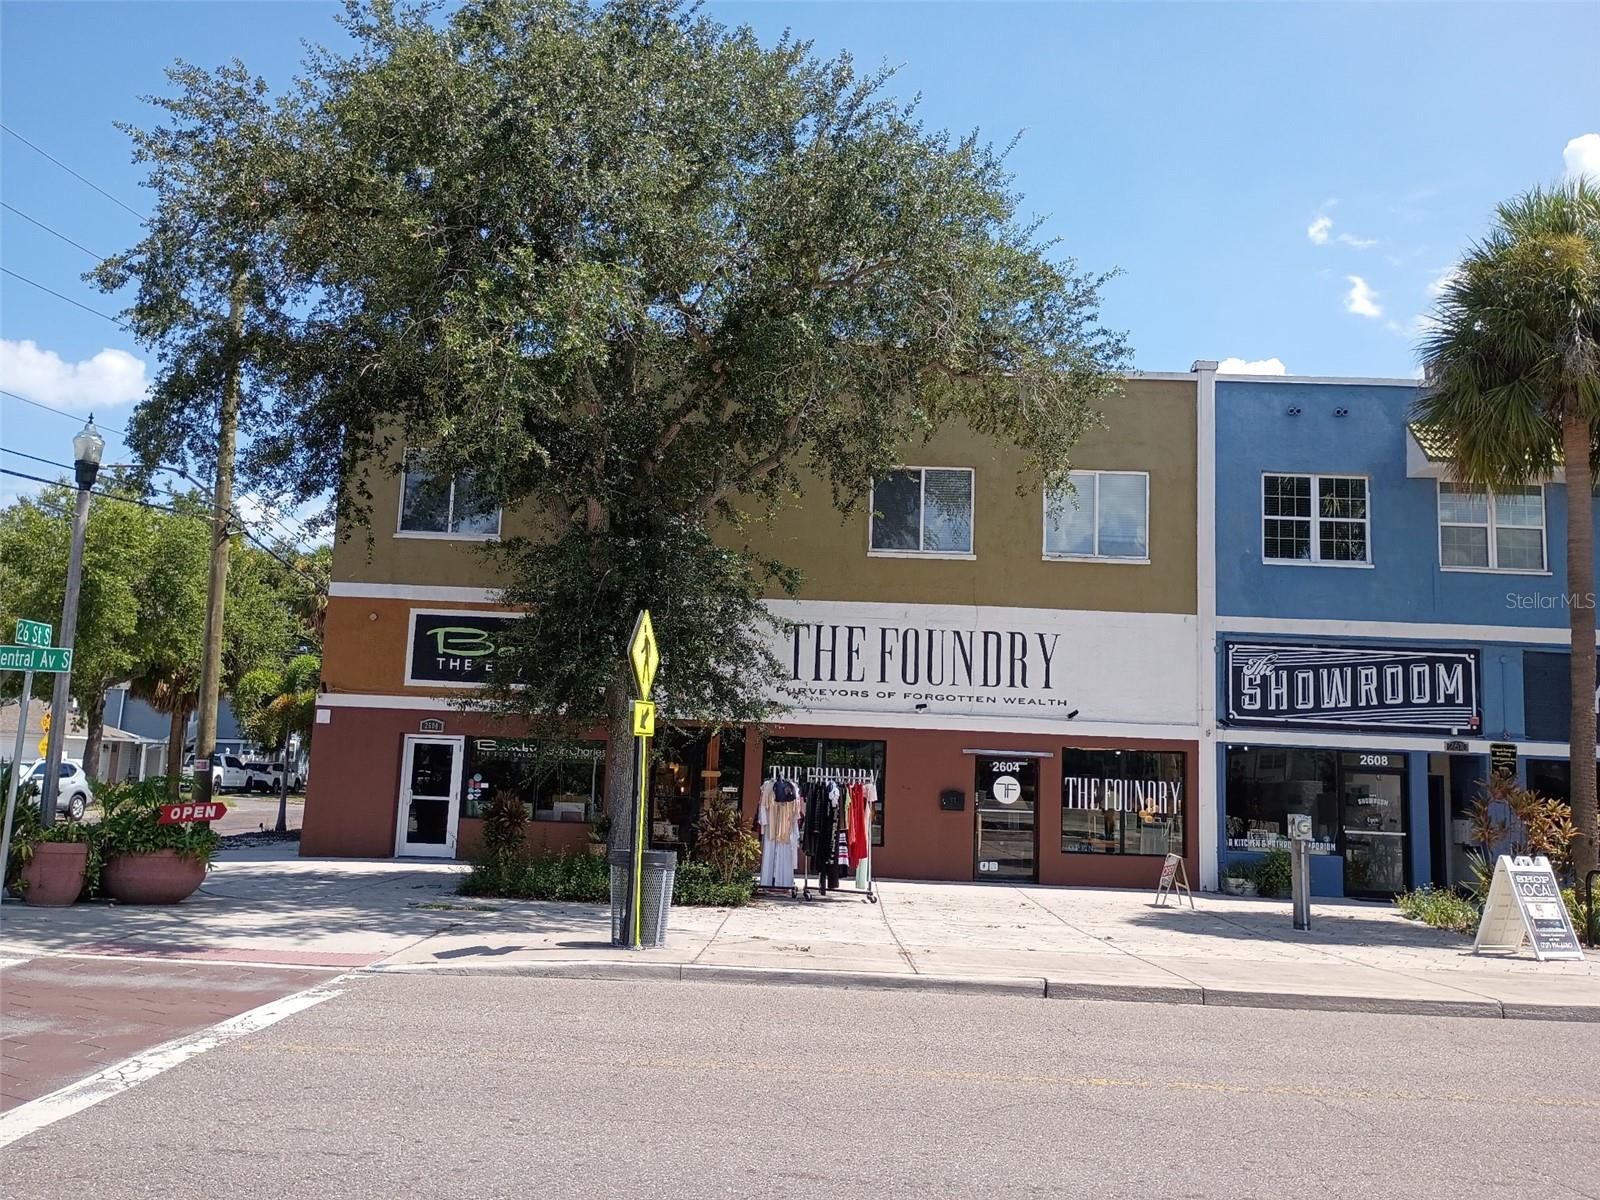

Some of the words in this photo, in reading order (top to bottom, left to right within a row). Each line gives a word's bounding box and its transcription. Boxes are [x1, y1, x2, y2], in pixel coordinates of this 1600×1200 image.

[17, 622, 29, 641] 26
[32, 625, 42, 644] St
[44, 627, 50, 645] S
[0, 650, 35, 667] entral
[40, 650, 56, 668] Av
[61, 651, 70, 669] S
[436, 657, 473, 671] THE
[791, 624, 866, 683] THE
[876, 626, 1061, 690] FOUNDRY
[1242, 653, 1280, 676] The
[1241, 663, 1464, 710] SHOWROOM
[876, 691, 896, 699] OF
[903, 692, 996, 704] FORGOTTEN
[1003, 697, 1068, 706] WEALTH
[992, 761, 1020, 773] 2604
[1360, 755, 1389, 766] 2608
[1064, 777, 1101, 811] THE
[1104, 778, 1181, 815] FOUNDRY
[169, 805, 217, 820] OPEN
[1234, 838, 1260, 848] KITCHEN
[1268, 840, 1292, 850] BATHRO
[1515, 875, 1550, 884] SHOP
[1519, 883, 1555, 897] LOCAL
